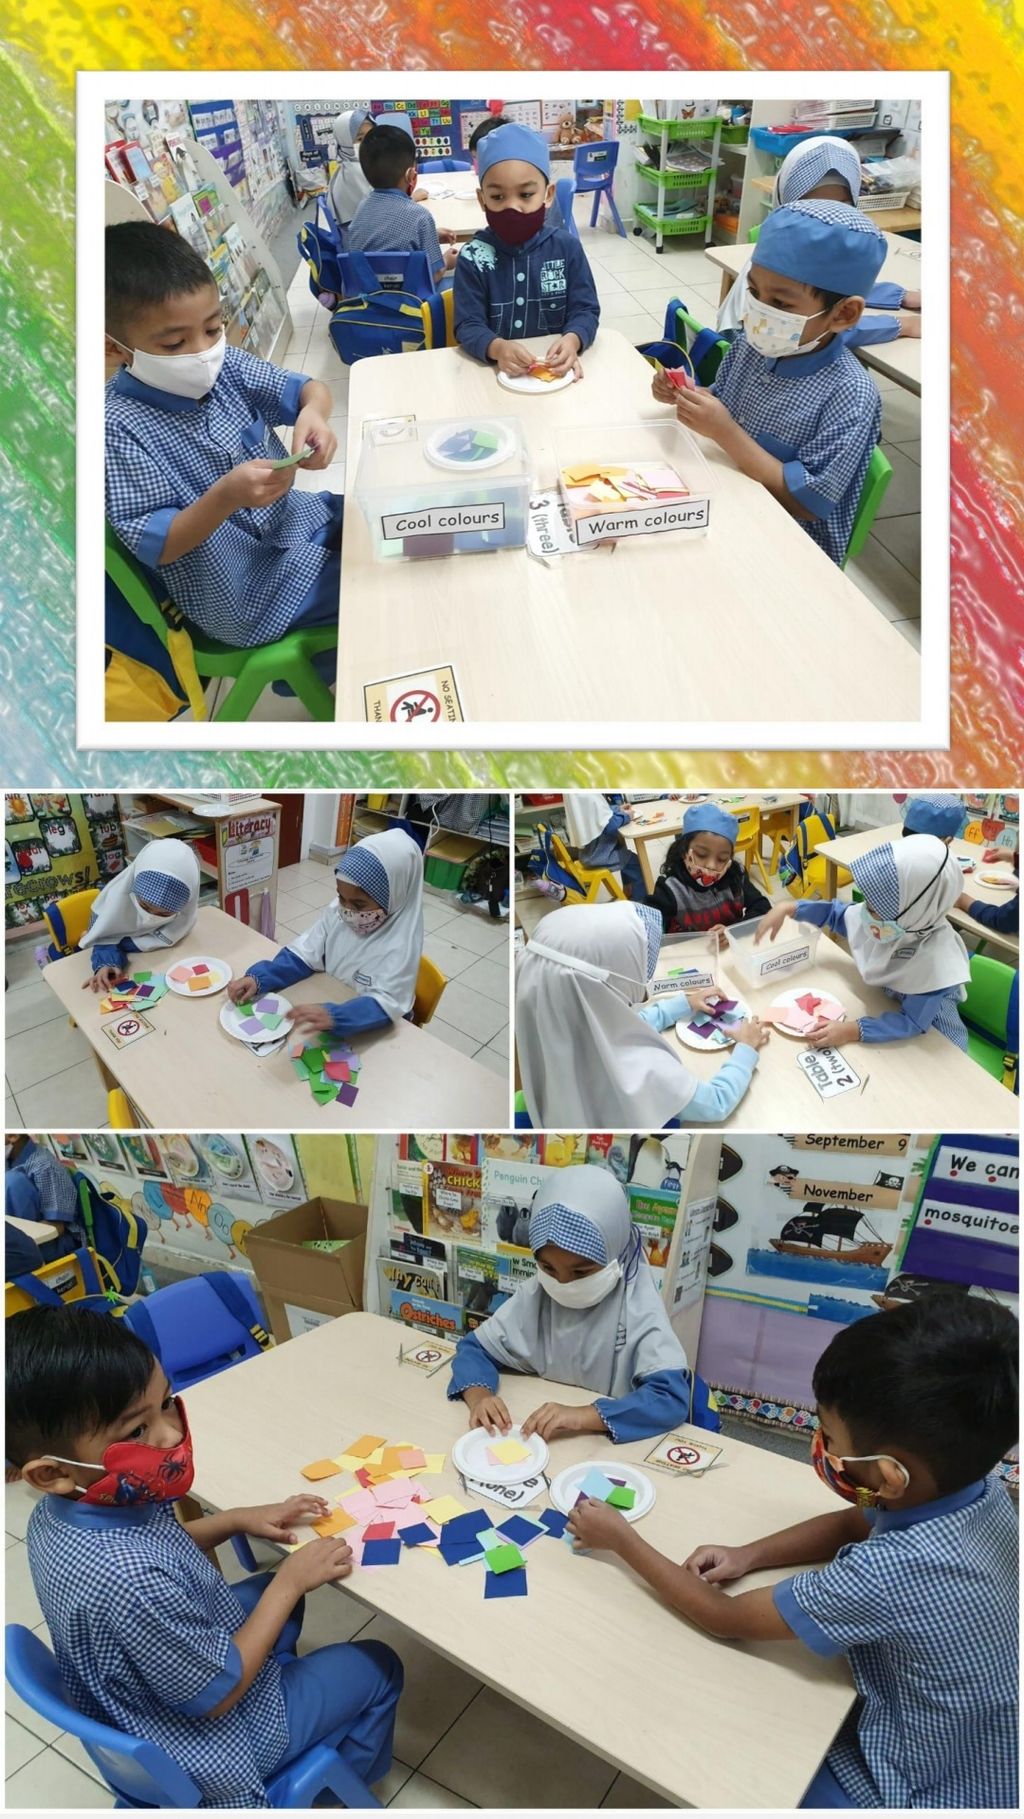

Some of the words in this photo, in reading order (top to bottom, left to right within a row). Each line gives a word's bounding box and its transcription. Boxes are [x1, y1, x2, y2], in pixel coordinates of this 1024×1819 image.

[529, 499, 550, 511] 3
[395, 514, 431, 532] Cool
[438, 512, 500, 527] colours
[588, 519, 639, 535] Warm
[644, 508, 705, 528] colours
[531, 513, 560, 554] (three)
[440, 679, 451, 693] NO
[48, 825, 66, 836] leg
[228, 817, 271, 838] Literacy
[765, 958, 782, 970] Cool
[782, 950, 808, 965] colours
[679, 977, 711, 988] colours
[804, 1054, 834, 1091] Table
[836, 1074, 854, 1087] 2
[805, 1133, 885, 1150] September
[897, 1138, 907, 1151] 9
[950, 1154, 977, 1172] We
[985, 1163, 1019, 1180] can
[447, 1175, 481, 1189] CHICK
[494, 1170, 528, 1185] Penguin
[803, 1184, 874, 1203] November
[400, 1301, 457, 1331] Ostriches
